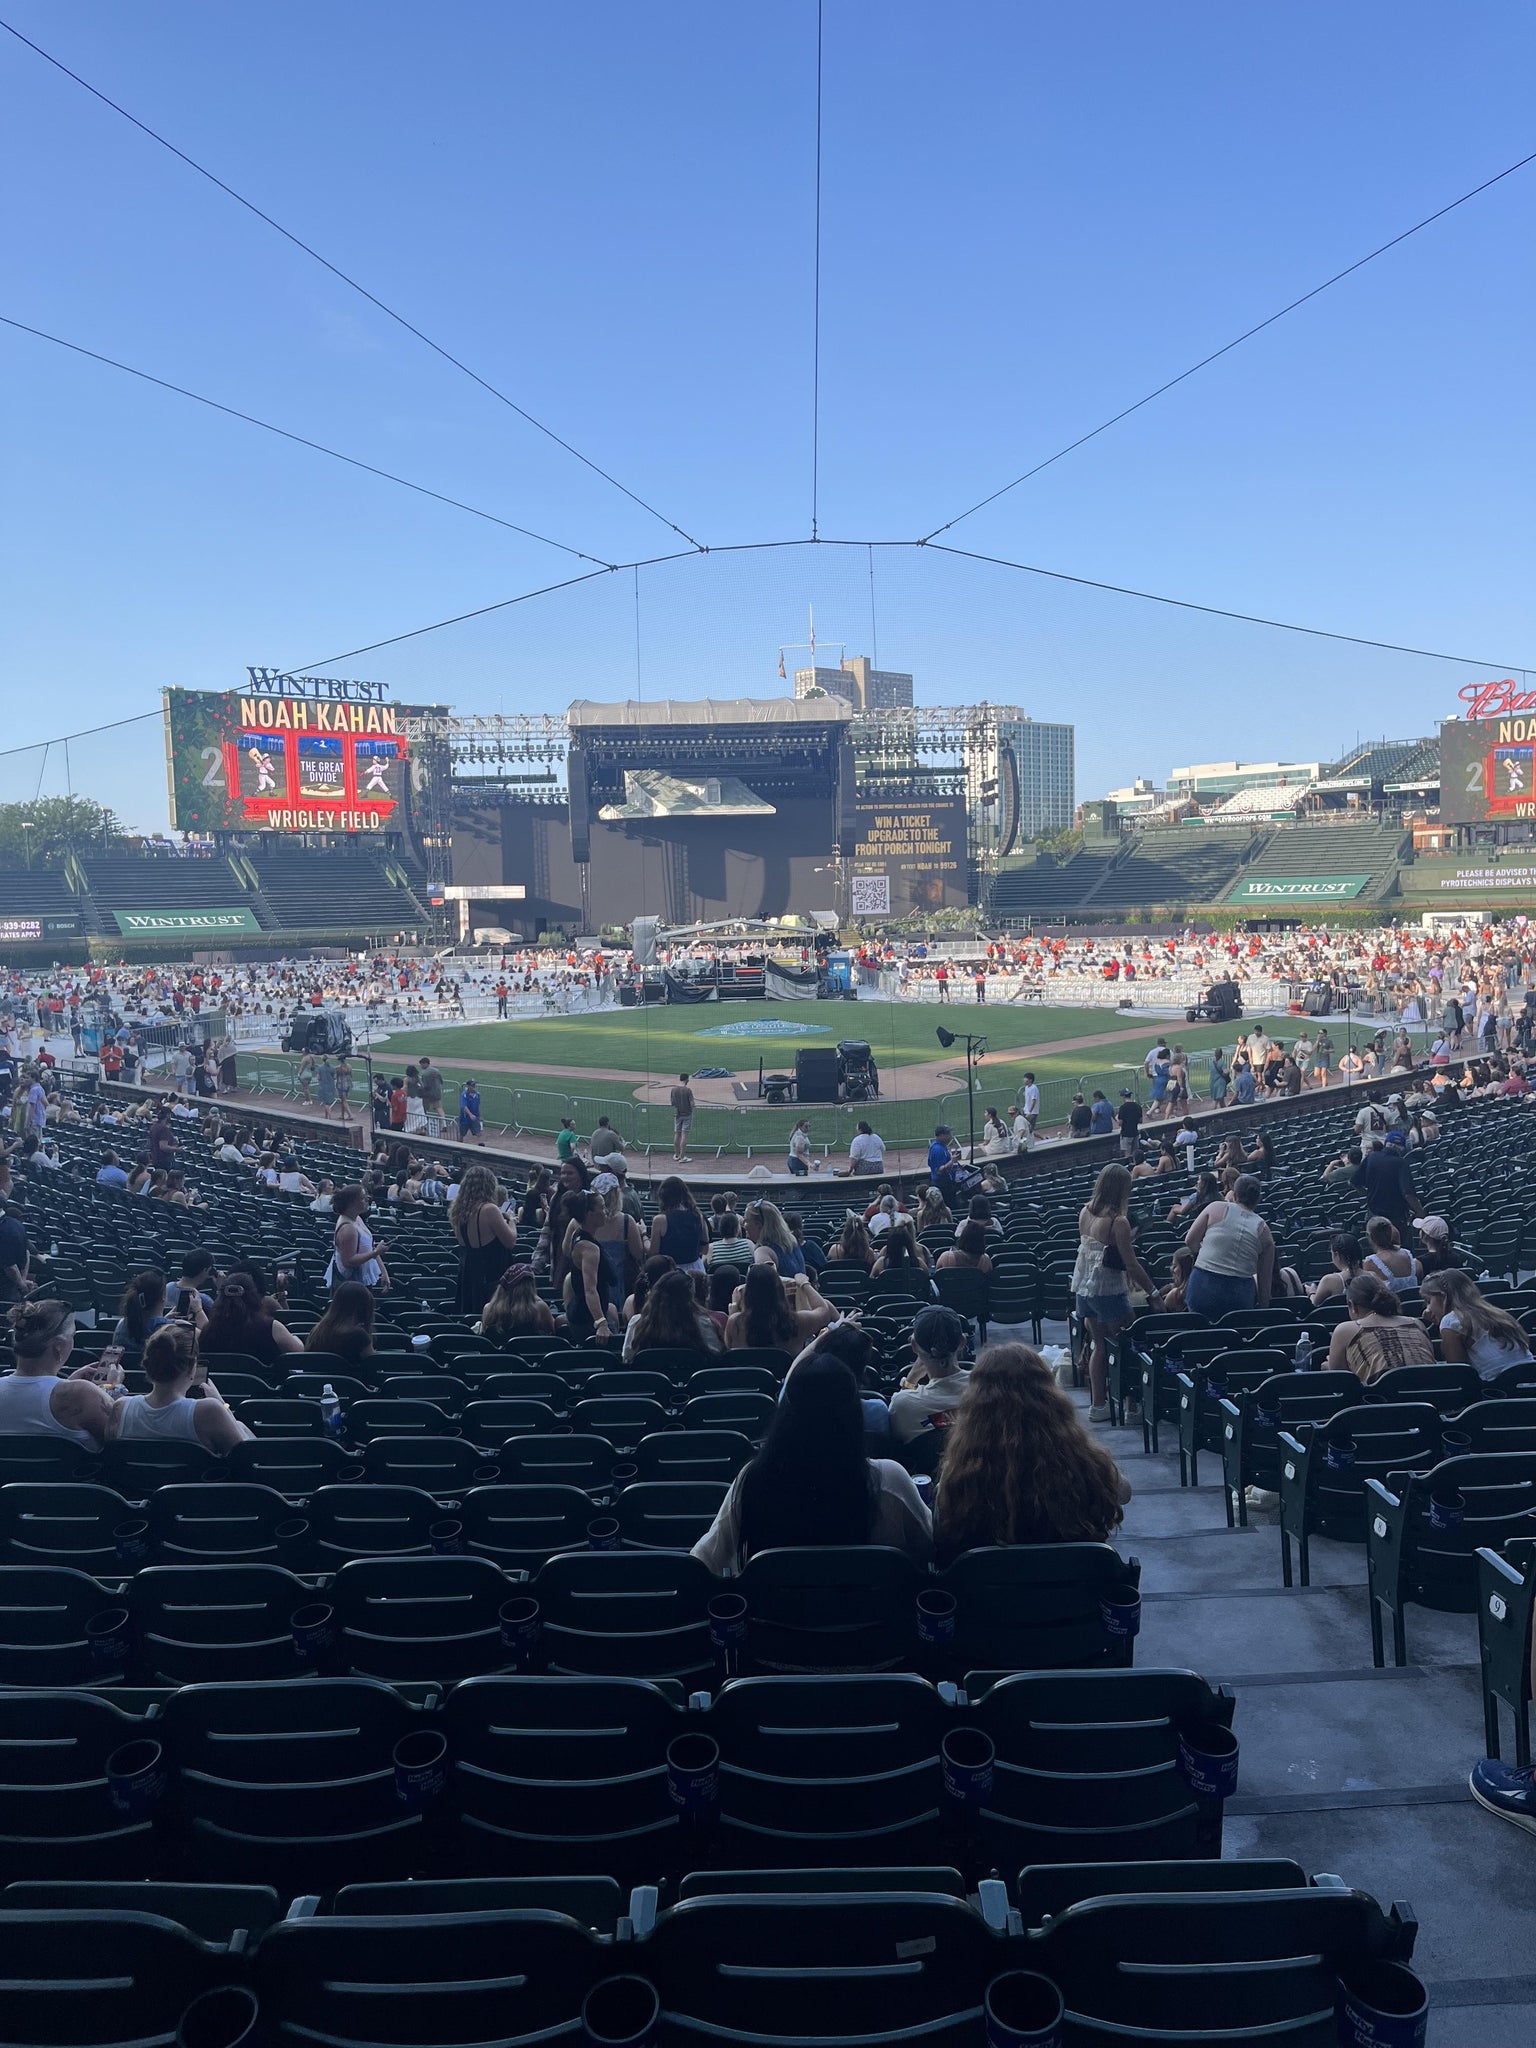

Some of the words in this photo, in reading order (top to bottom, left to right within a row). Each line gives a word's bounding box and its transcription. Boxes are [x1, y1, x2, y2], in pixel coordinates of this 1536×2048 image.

[240, 698, 307, 730] NOAH
[316, 703, 396, 734] KAHAN
[201, 746, 226, 787] 2
[300, 760, 317, 772] THE
[318, 761, 345, 773] GREAT
[309, 771, 337, 783] DIVIDE
[1465, 761, 1483, 792] 2
[267, 809, 334, 828] WRIGLEY
[340, 810, 379, 829] FIELD
[875, 816, 892, 828] WIN
[893, 815, 900, 828] A
[901, 815, 931, 828] TICKET
[868, 829, 909, 842] UPGRADE
[909, 829, 921, 841] TO
[922, 828, 939, 840] THE
[855, 843, 884, 856] FRONT
[884, 842, 914, 855] PORCH
[914, 841, 952, 854] TONIGHT
[1456, 870, 1484, 878] PLEASE
[1485, 869, 1495, 877] BE
[1496, 868, 1528, 877] ADVISED
[1441, 879, 1494, 888] PYROTECHNICS
[1495, 877, 1532, 886] DISPLAYS
[1494, 1600, 1501, 1612] 9
